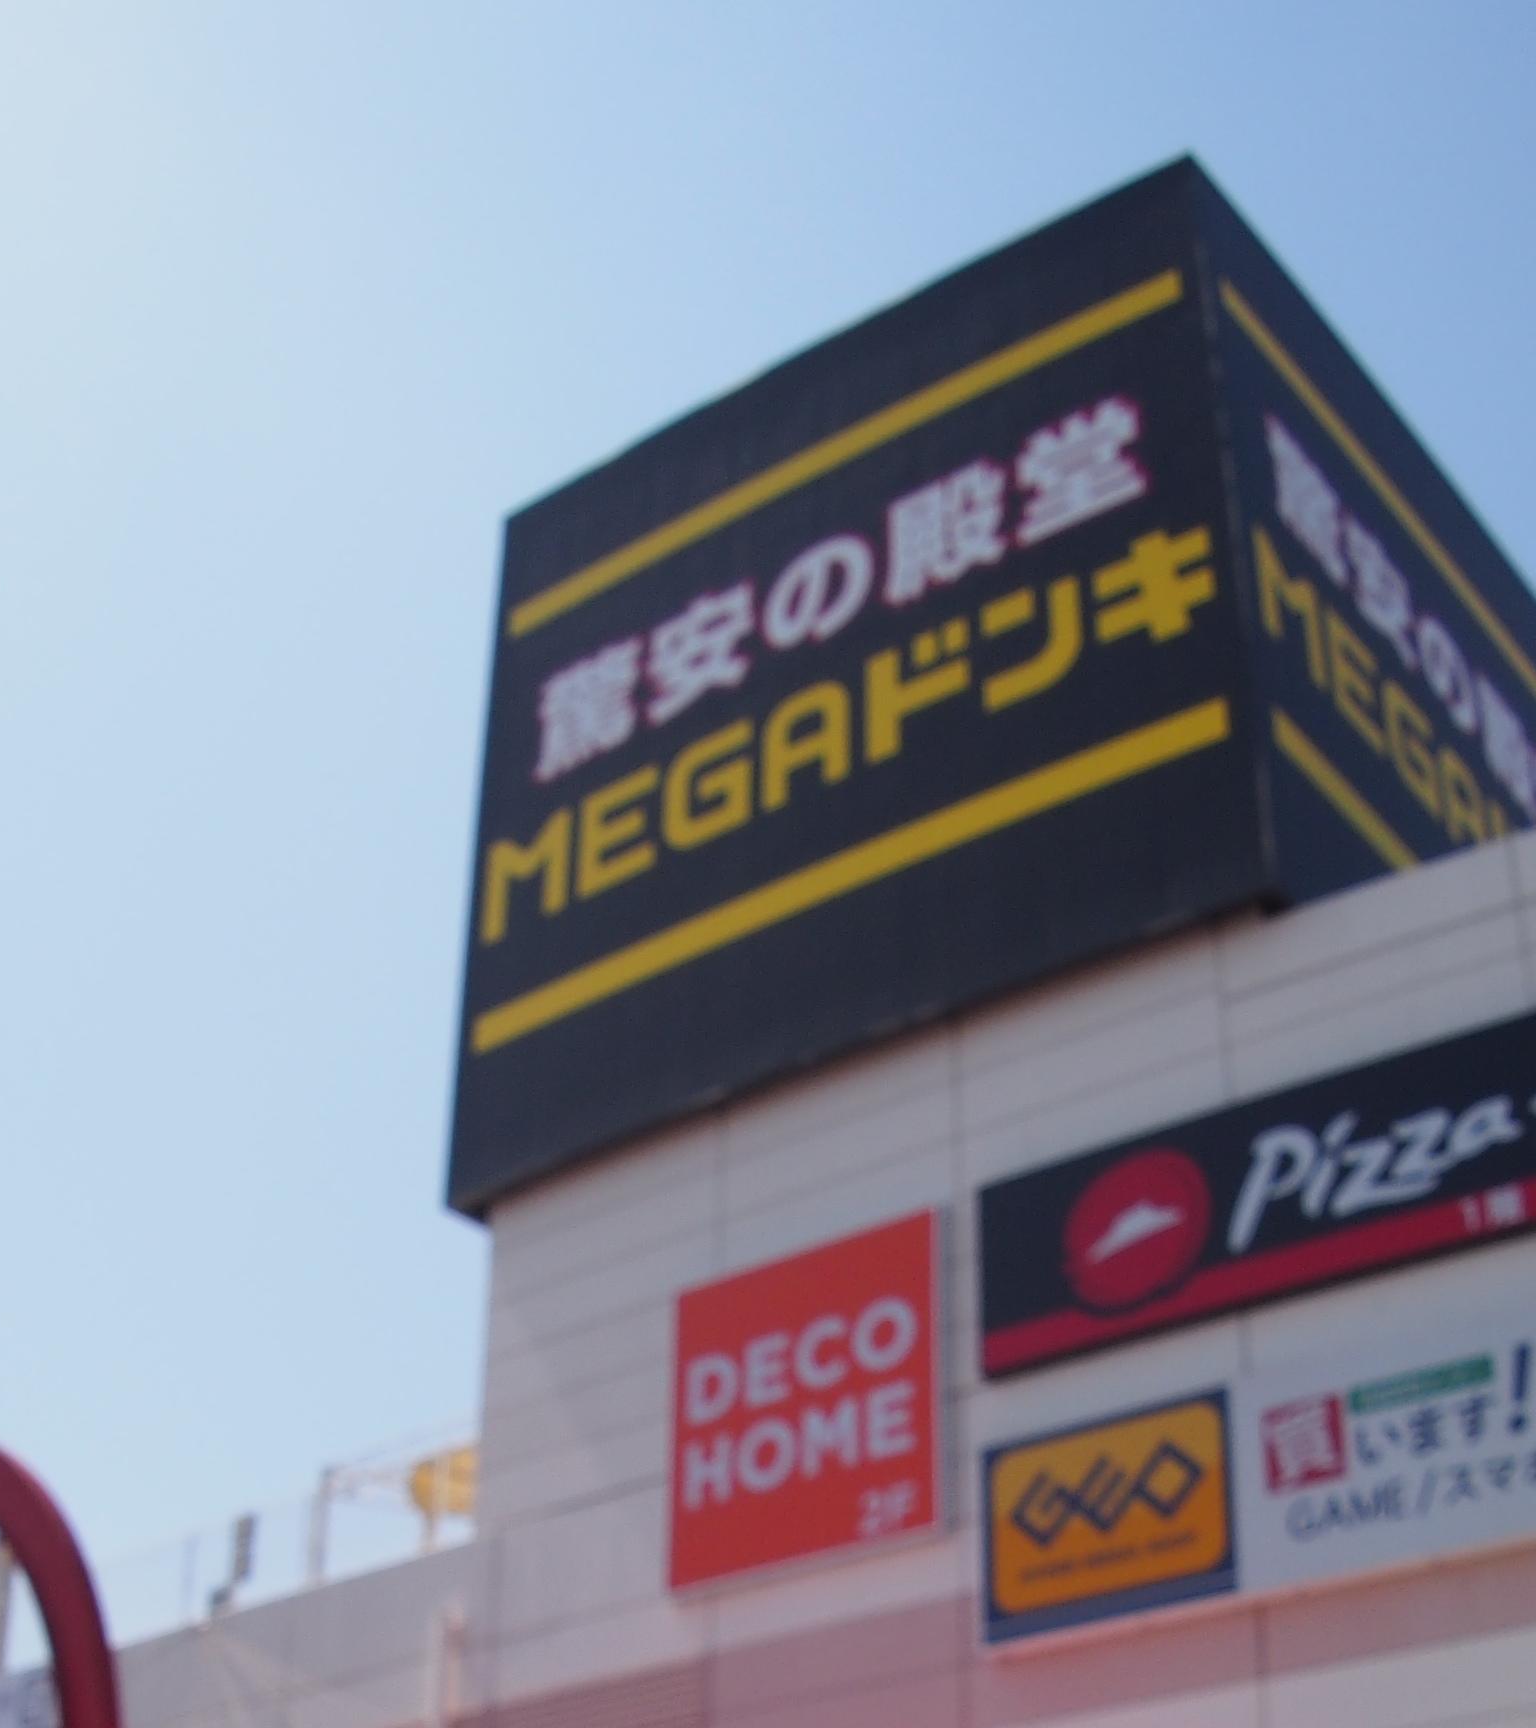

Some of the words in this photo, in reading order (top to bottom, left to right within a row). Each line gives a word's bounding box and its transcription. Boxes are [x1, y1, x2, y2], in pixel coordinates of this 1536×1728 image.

[531, 396, 1148, 784] 驚安の殿堂
[1252, 522, 1508, 846] MEGA
[480, 525, 1218, 946] MEGAドンキ
[1227, 1095, 1522, 1254] Pizza
[680, 1379, 918, 1512] HOME
[682, 1296, 918, 1428] DECO
